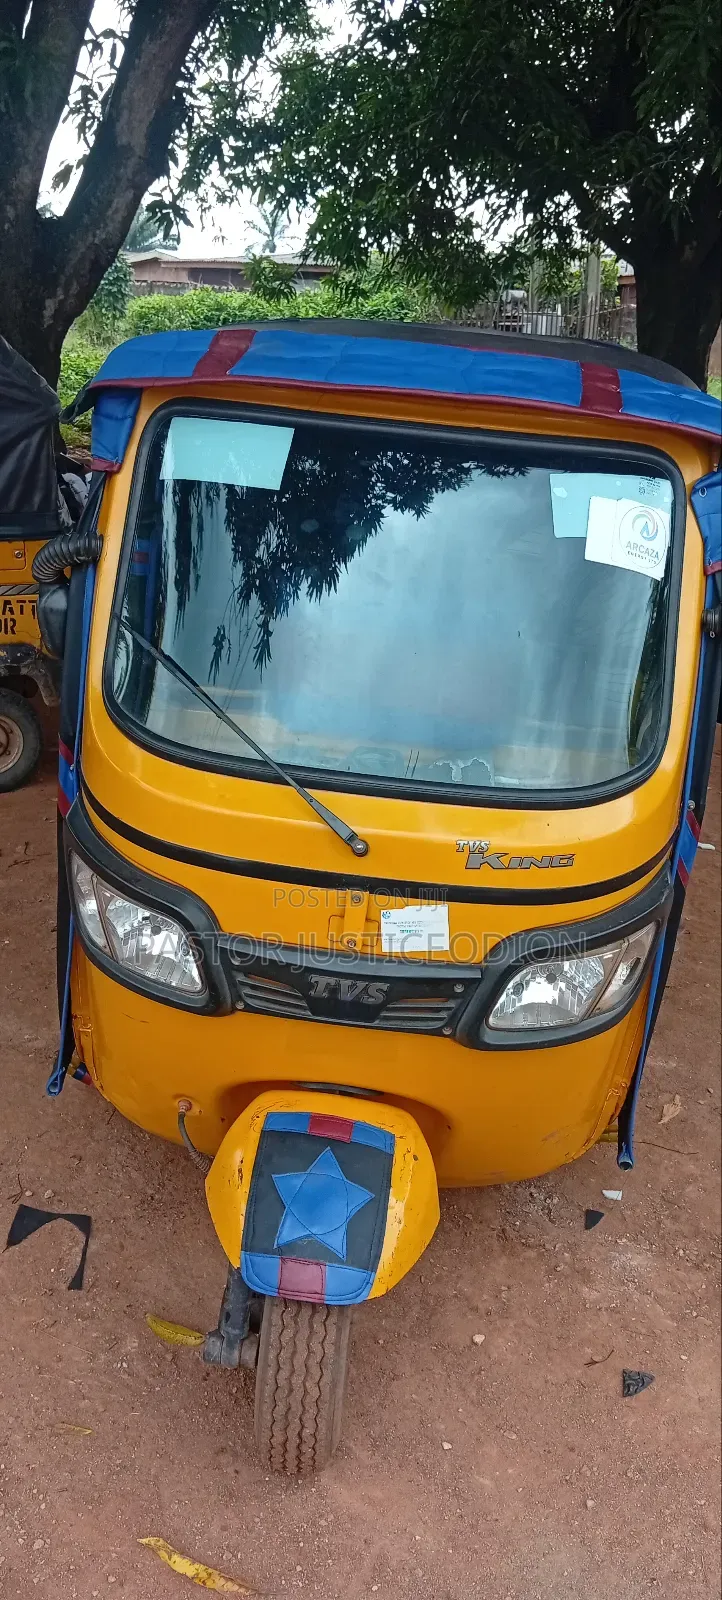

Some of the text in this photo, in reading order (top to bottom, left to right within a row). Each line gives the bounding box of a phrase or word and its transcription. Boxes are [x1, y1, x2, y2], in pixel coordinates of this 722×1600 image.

[625, 540, 660, 561] ARCAZA
[456, 839, 490, 853] TVS
[464, 852, 577, 870] KING
[308, 974, 391, 1006] TVS
